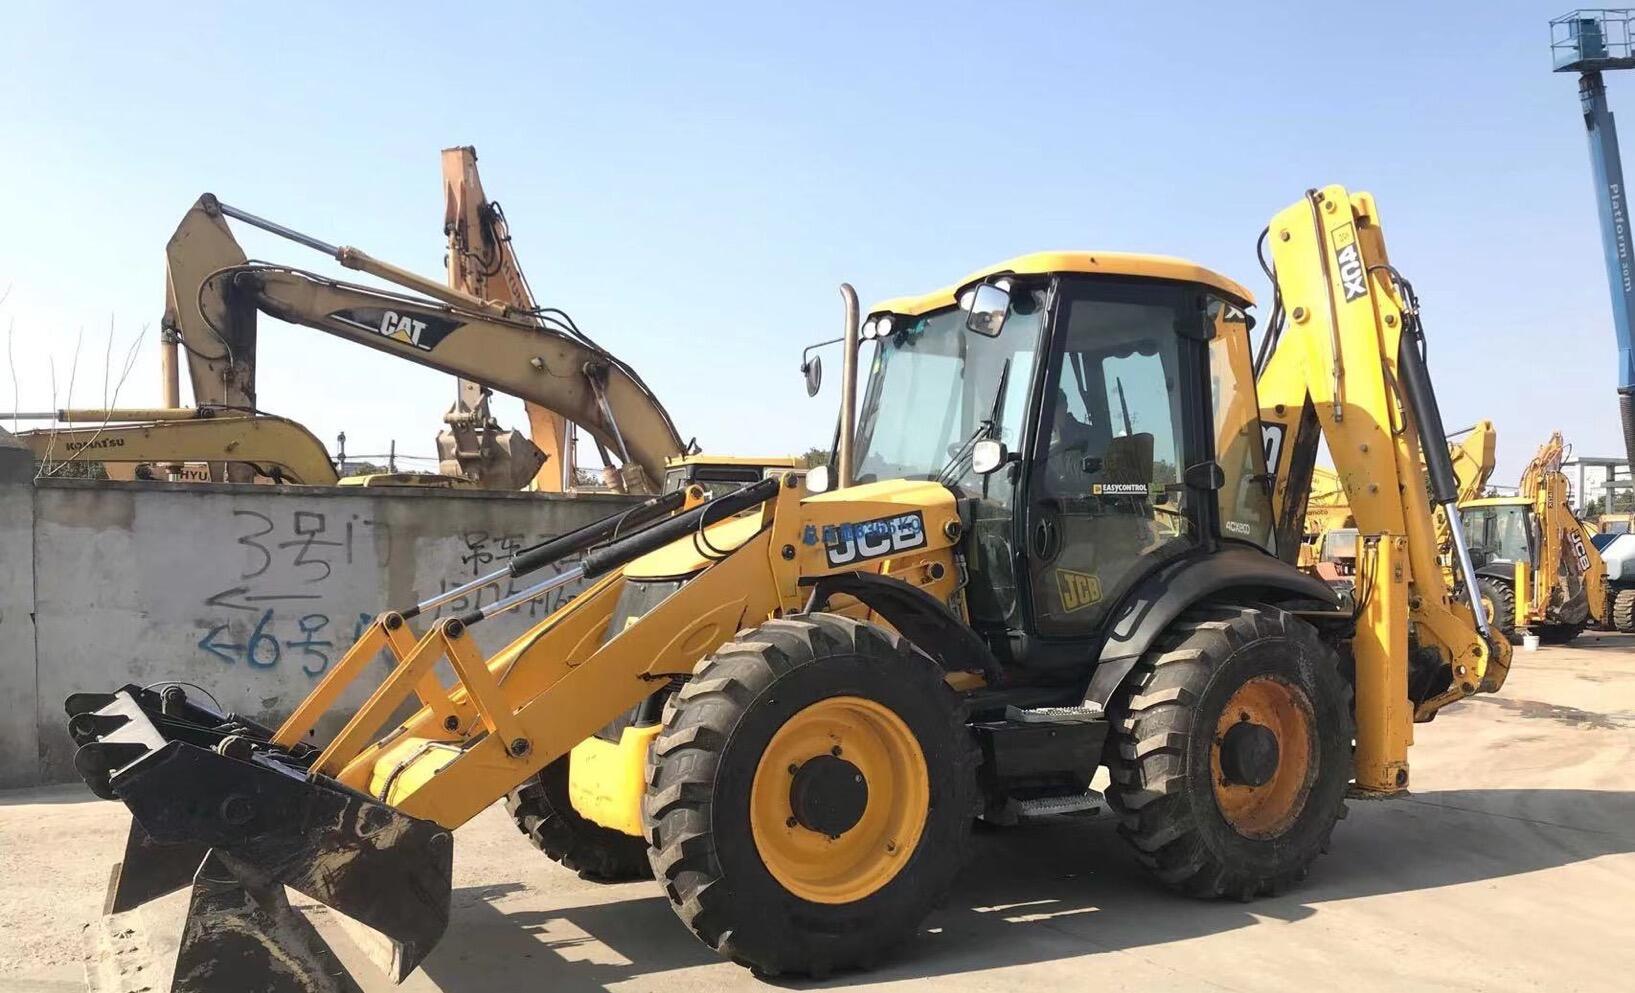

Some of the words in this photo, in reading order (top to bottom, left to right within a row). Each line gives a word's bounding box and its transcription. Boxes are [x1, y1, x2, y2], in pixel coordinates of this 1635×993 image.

[1610, 184, 1627, 258] Platform
[1338, 245, 1367, 299] 4CX
[380, 310, 427, 346] CAT
[66, 438, 125, 451] KOMATSU
[1102, 483, 1148, 493] EASYCONTROL
[828, 514, 924, 564] JCB
[1571, 530, 1592, 570] JCB
[1061, 573, 1101, 608] JCB
